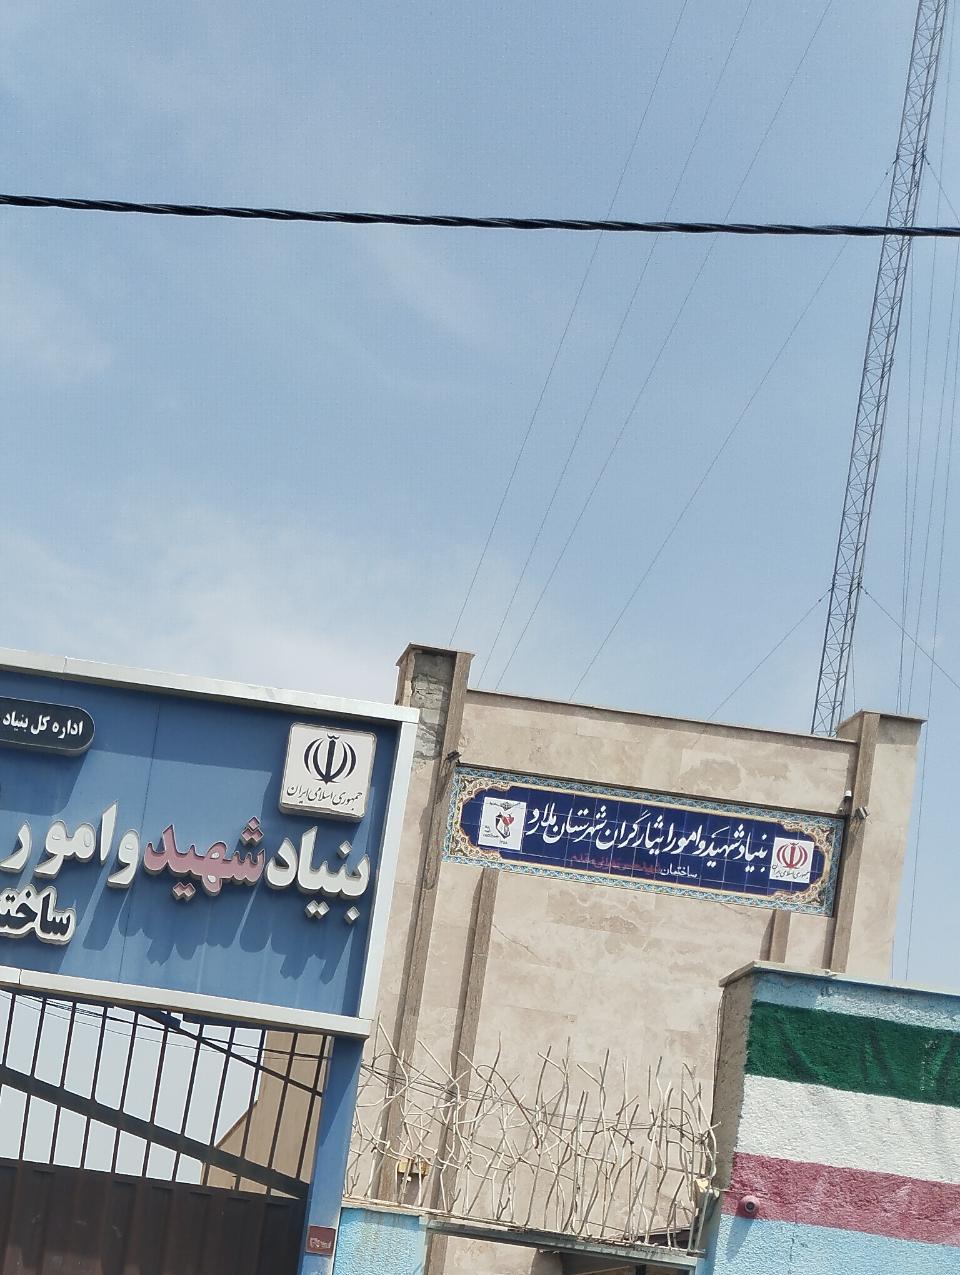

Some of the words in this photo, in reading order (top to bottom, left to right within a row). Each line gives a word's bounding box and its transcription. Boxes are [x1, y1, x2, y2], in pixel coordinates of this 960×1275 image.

[2, 710, 29, 733] بنیاد
[30, 714, 51, 735] کل
[52, 719, 84, 740] اداره
[286, 784, 309, 804] ایران
[307, 786, 334, 802] اسلامی
[331, 791, 363, 811] جمهوری
[525, 802, 557, 836] ملارد
[542, 805, 608, 844] شهرستان
[0, 800, 119, 879] امور
[661, 824, 703, 855] امور
[699, 823, 745, 868] شهید
[733, 831, 769, 873] بنیاد
[107, 827, 140, 888] و
[143, 814, 267, 902] شهید
[659, 863, 698, 879] ساختمان
[266, 824, 370, 926] بنیاد
